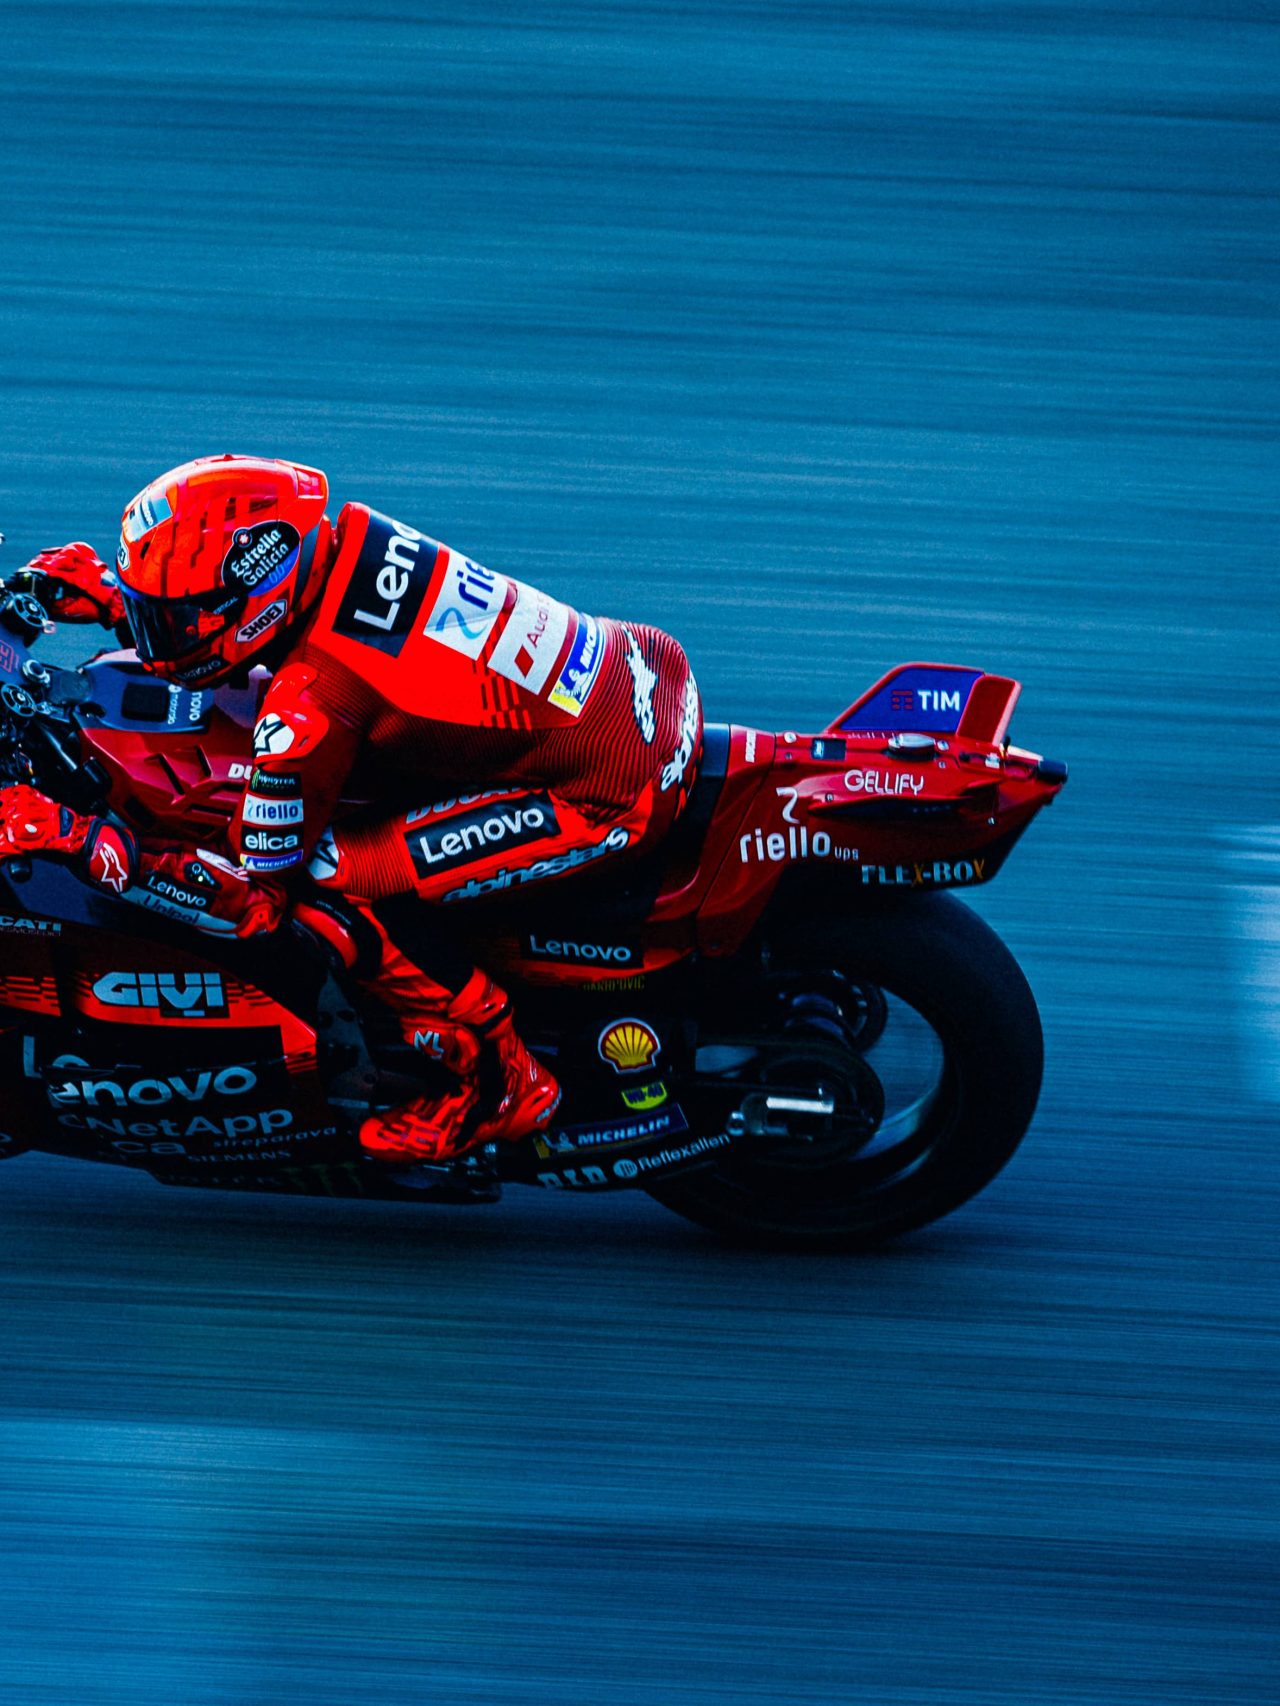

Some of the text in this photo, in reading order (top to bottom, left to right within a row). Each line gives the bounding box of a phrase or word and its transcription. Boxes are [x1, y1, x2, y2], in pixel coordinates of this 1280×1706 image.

[231, 529, 282, 577] Estrella
[243, 542, 289, 586] Galicia
[240, 605, 282, 640] SHOEI
[917, 689, 962, 711] TIM
[844, 769, 924, 796] GELLIFY
[256, 803, 299, 820] riello
[245, 831, 298, 851] elica
[420, 807, 544, 864] Lenovo
[740, 825, 831, 863] riello
[147, 876, 207, 907] Lenovo
[530, 935, 632, 962] Lenovo
[92, 971, 225, 1009] GIVI
[577, 1115, 670, 1146] MICHELIN
